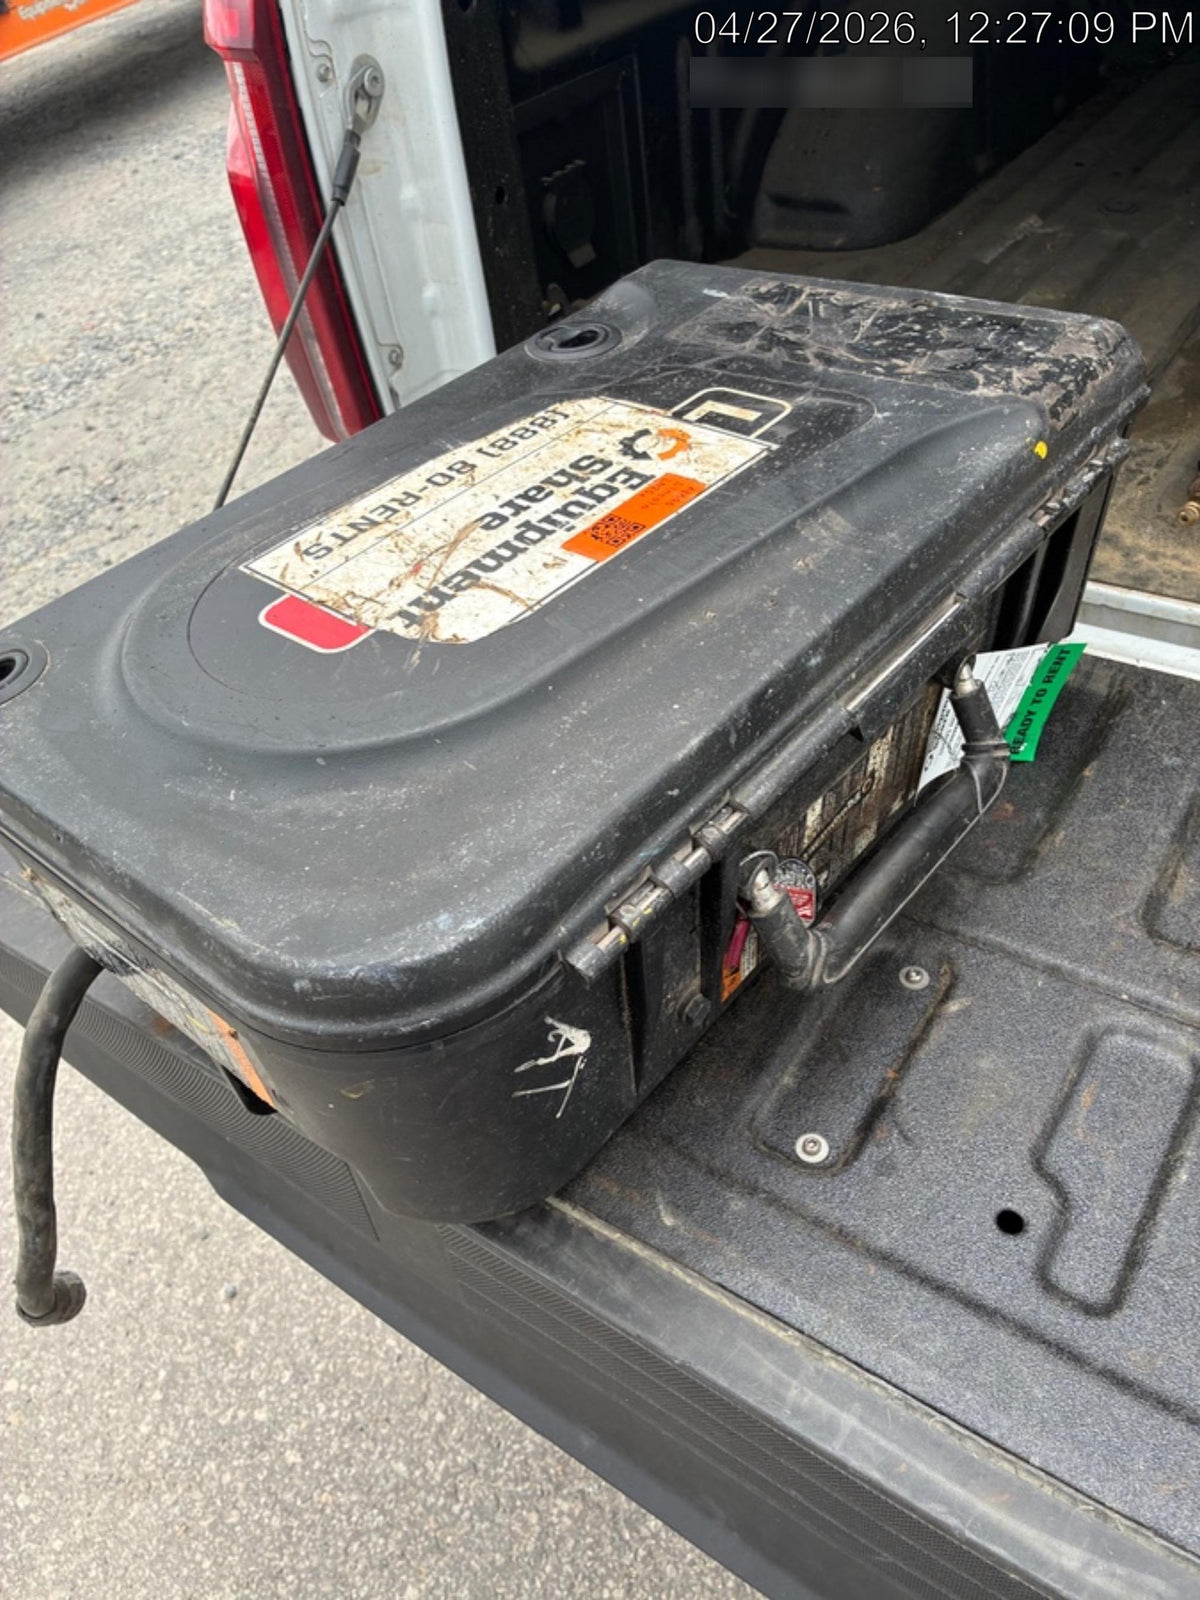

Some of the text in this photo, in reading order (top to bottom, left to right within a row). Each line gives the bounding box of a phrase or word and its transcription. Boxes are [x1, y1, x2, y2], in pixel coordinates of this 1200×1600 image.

[303, 460, 477, 560] 80-RENTS
[478, 454, 613, 531] Share
[391, 467, 656, 629] Equipment
[1009, 709, 1037, 755] READY
[1030, 688, 1048, 705] TO
[1042, 649, 1071, 684] RENT
